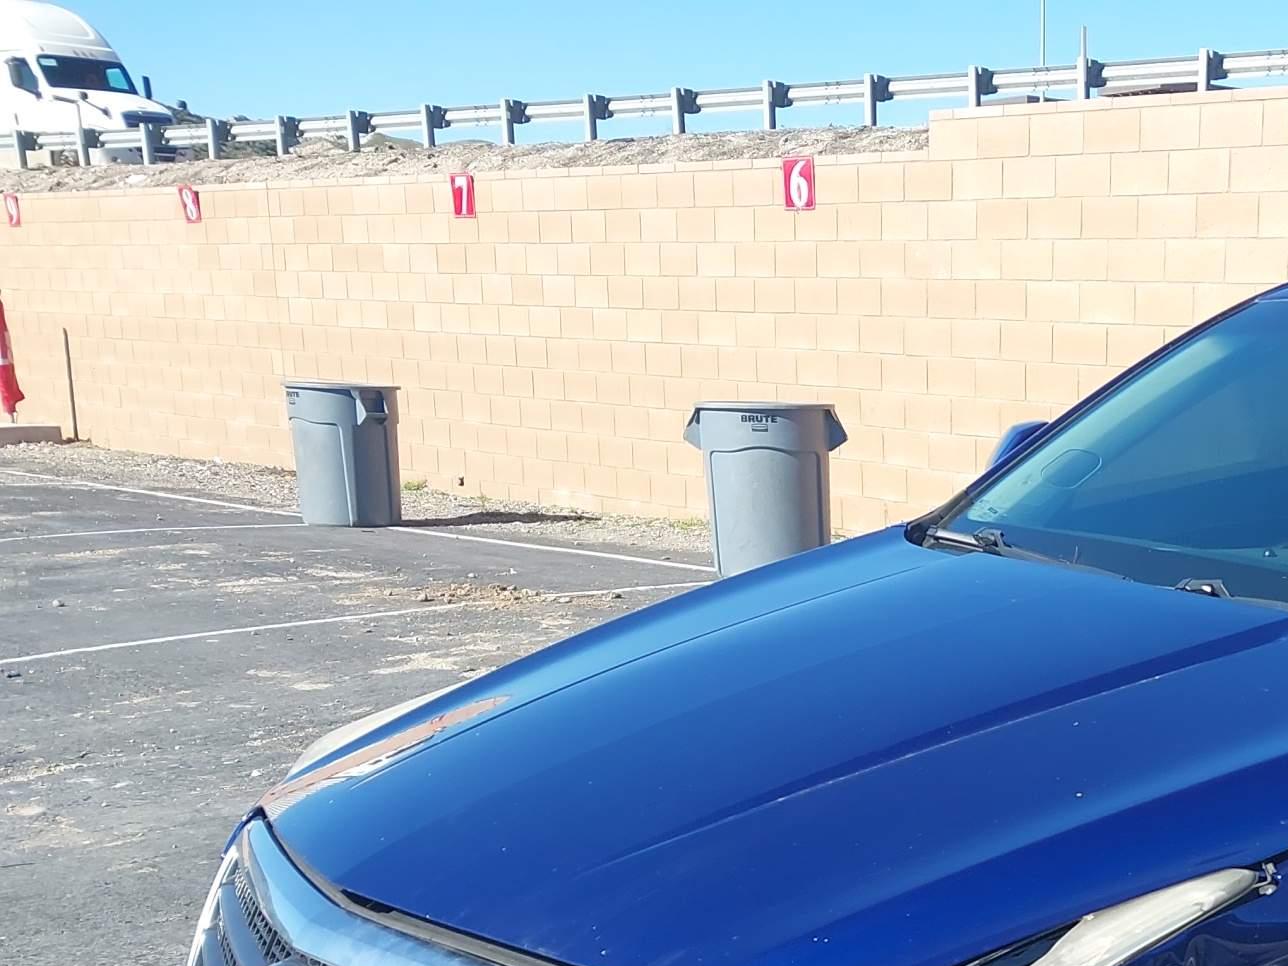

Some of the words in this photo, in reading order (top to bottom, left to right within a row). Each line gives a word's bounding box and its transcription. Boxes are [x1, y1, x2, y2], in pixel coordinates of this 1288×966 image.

[454, 175, 468, 215] 7
[789, 160, 809, 208] 6
[6, 197, 17, 224] 9
[182, 188, 197, 220] 8
[740, 414, 778, 424] BRUTE
